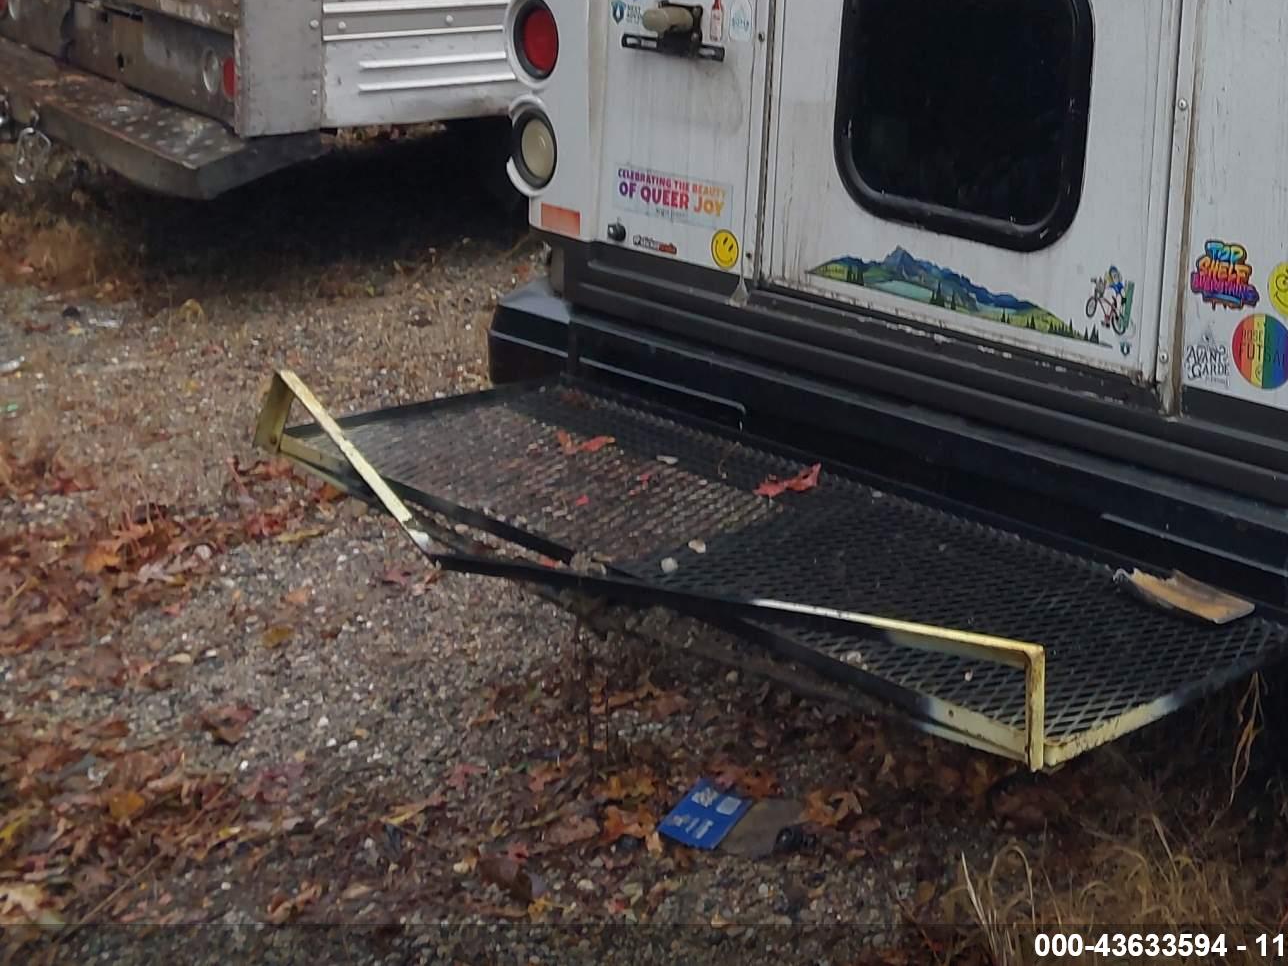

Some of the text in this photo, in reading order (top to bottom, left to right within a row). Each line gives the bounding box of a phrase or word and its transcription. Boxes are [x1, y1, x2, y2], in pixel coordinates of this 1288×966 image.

[618, 168, 726, 199] CELEBRATING THE BEAUTY
[619, 181, 637, 199] OF
[640, 186, 690, 210] QUEER
[694, 195, 725, 218] JOY
[1206, 241, 1246, 264] TOP
[1198, 256, 1251, 284] SHELF
